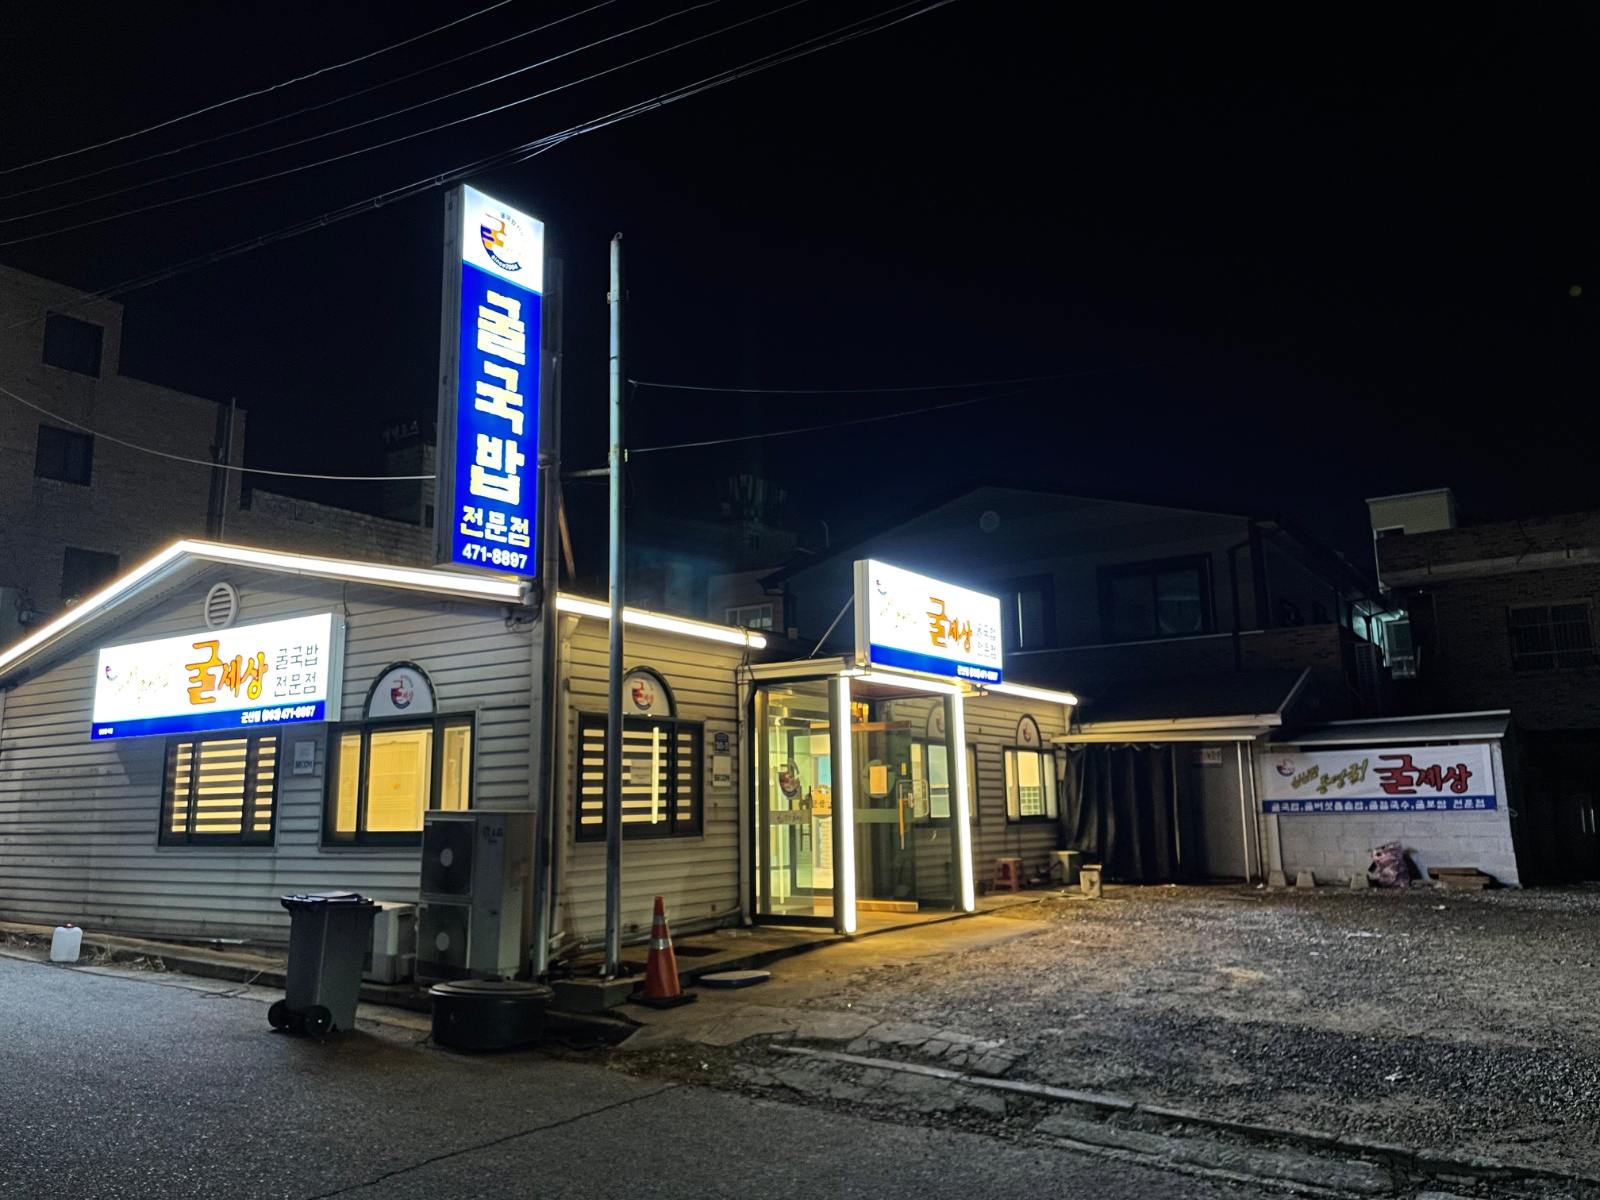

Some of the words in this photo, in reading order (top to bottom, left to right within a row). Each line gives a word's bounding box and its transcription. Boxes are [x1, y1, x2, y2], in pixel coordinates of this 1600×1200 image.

[469, 289, 526, 506] 굴국밥
[460, 505, 530, 548] 전문점
[462, 543, 528, 569] 471-8897
[926, 597, 973, 654] 굴세상
[185, 639, 269, 705] 굴세상
[275, 644, 319, 670] 굴국밥
[274, 672, 317, 697] 전문점
[1373, 754, 1472, 795] 굴세상
[491, 827, 503, 838] LG
